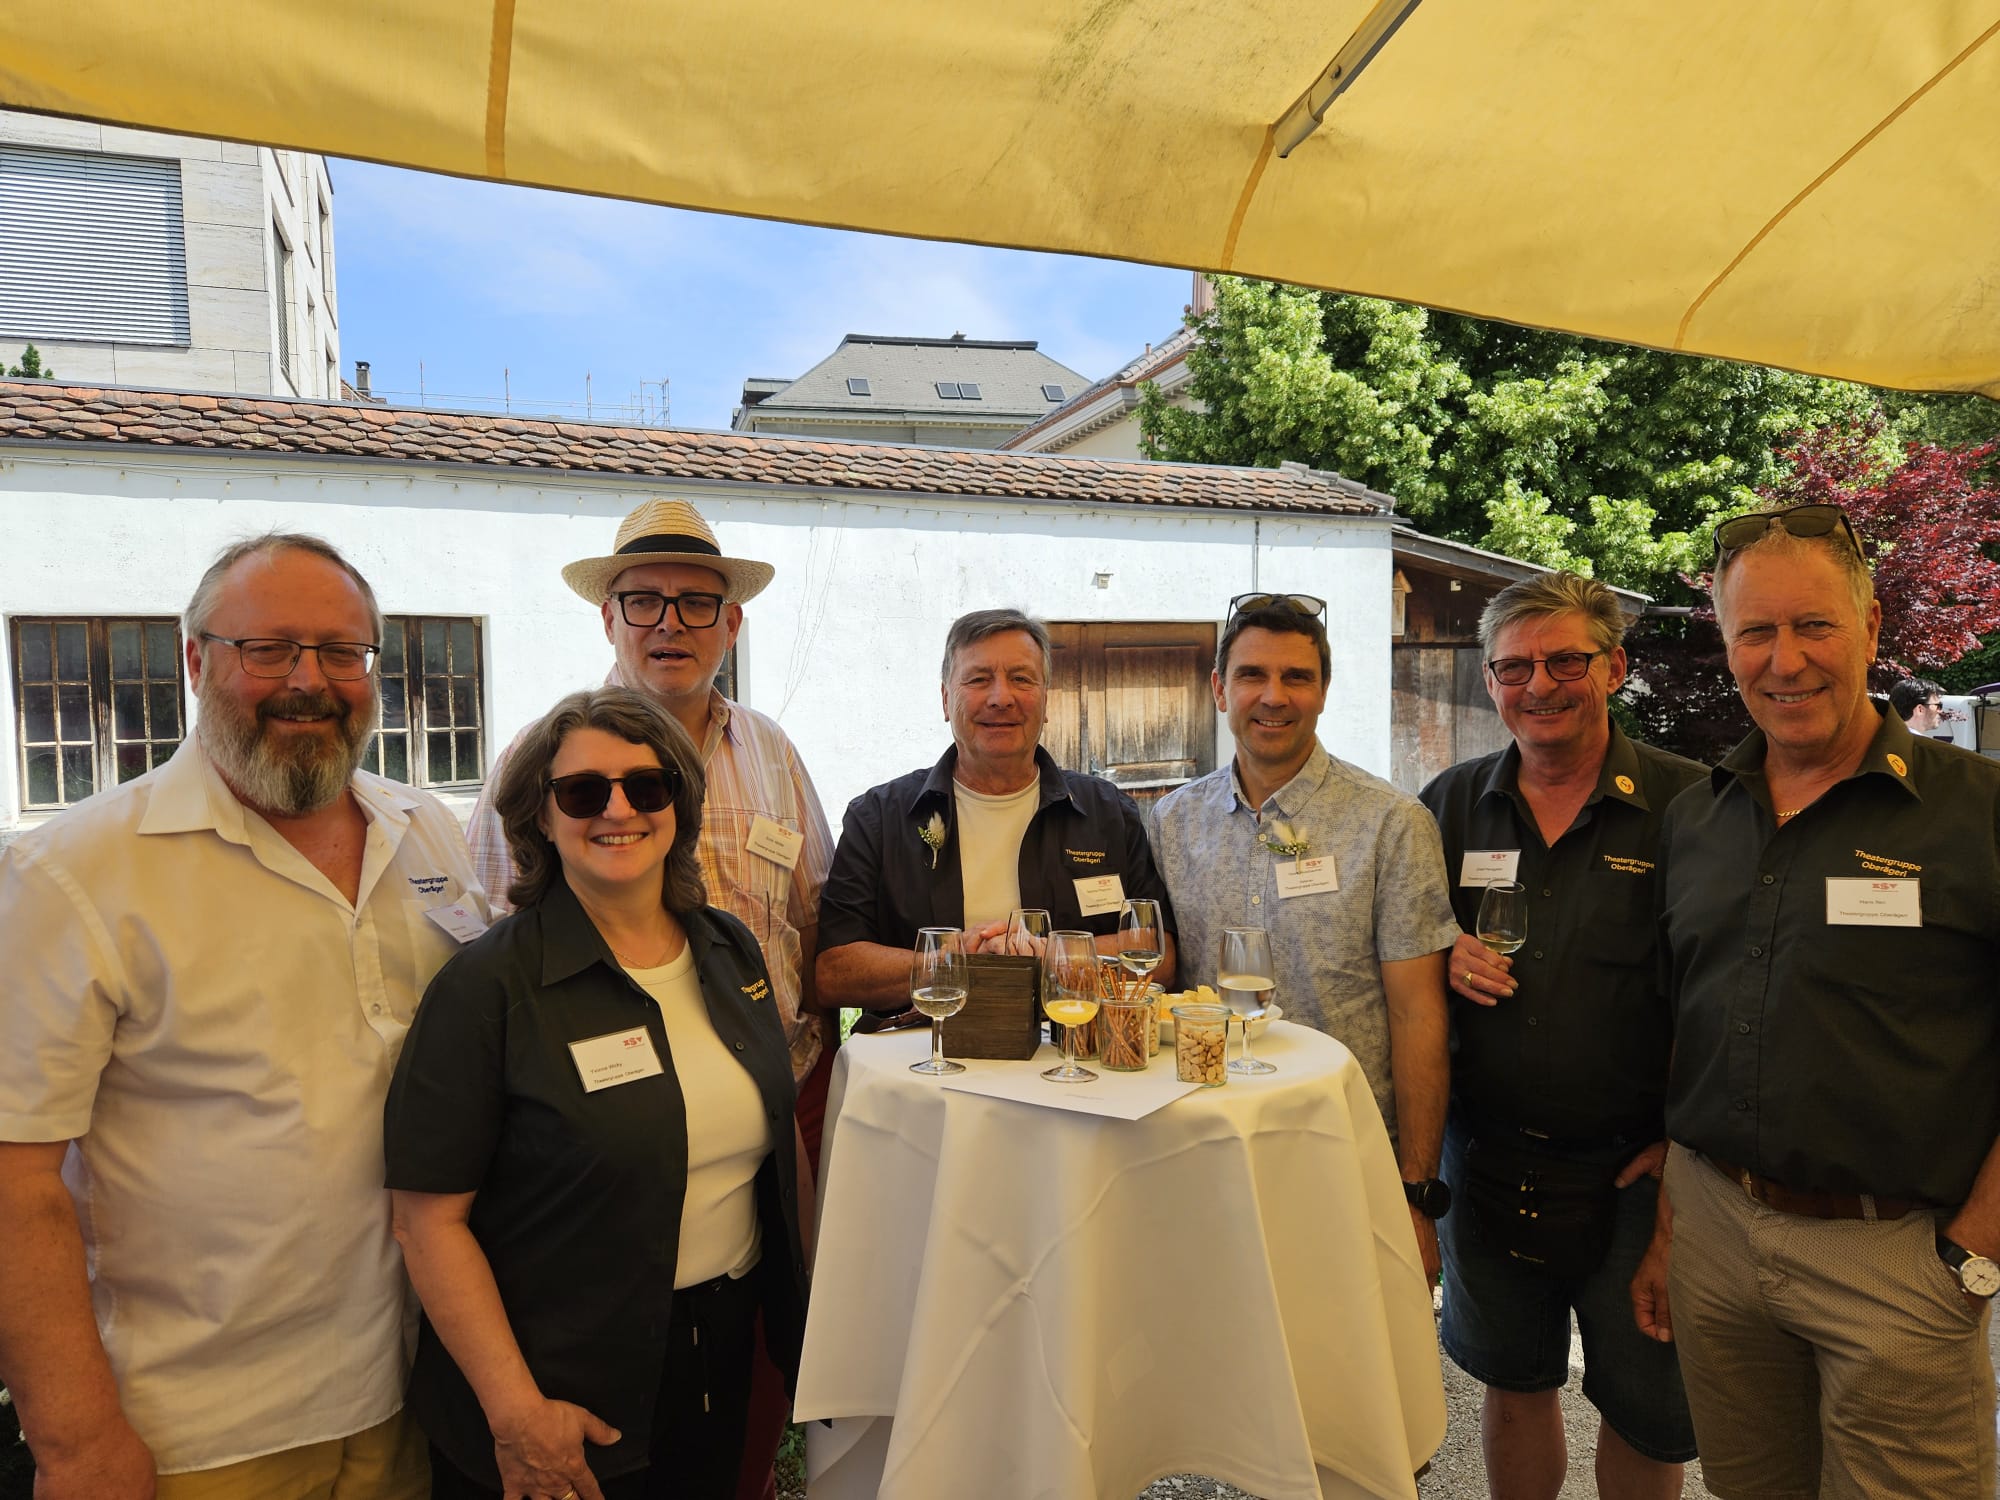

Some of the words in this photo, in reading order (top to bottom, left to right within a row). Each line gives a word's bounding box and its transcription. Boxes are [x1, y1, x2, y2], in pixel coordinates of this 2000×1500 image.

[1065, 849, 1106, 857] Theatergruppe
[1604, 855, 1655, 869] Theatergruppe
[1855, 849, 1922, 872] Theatergruppe
[1611, 863, 1646, 874] Oberägeri
[1861, 861, 1909, 877] Oberägeri
